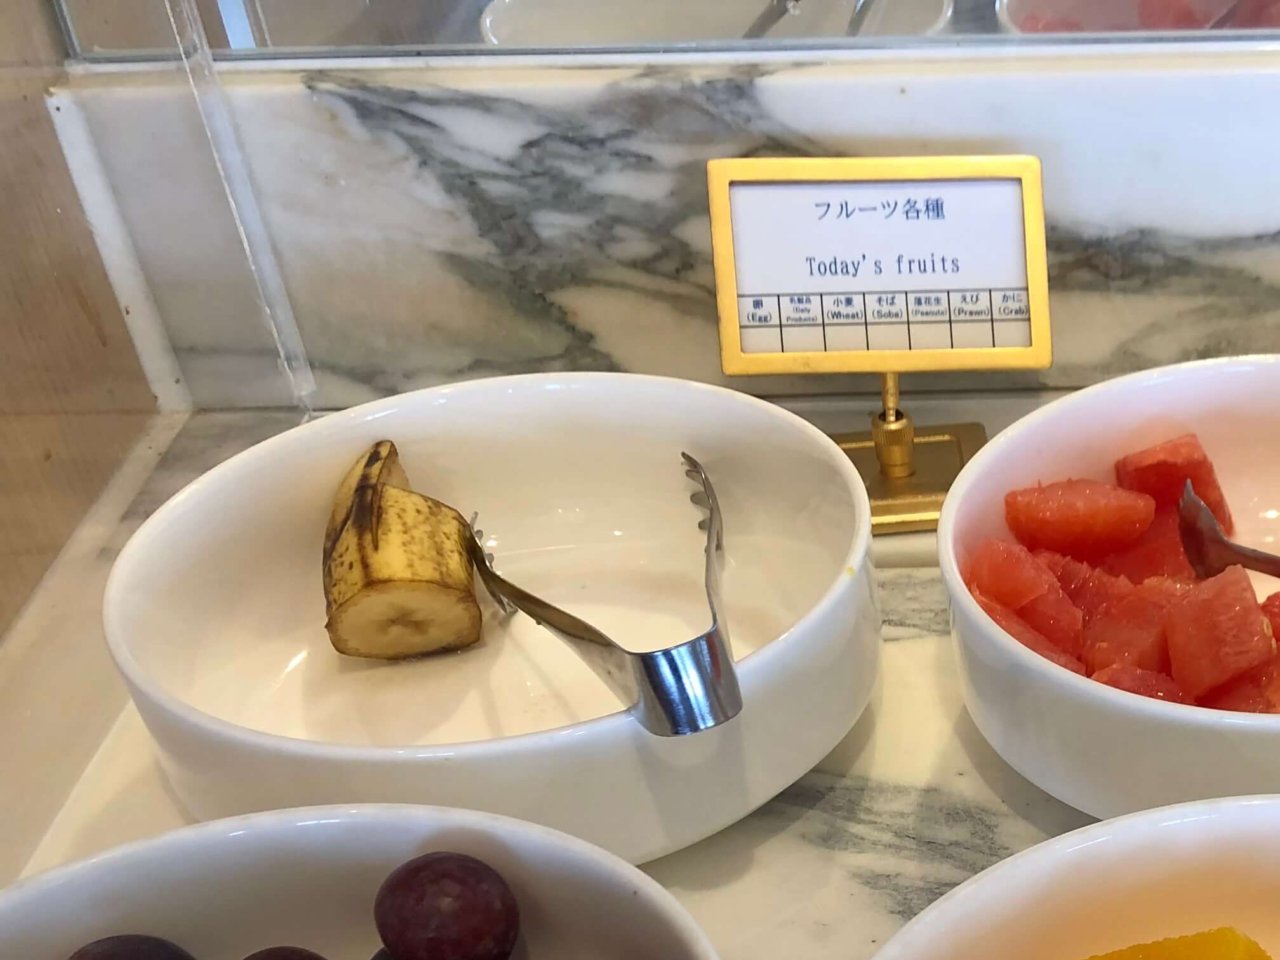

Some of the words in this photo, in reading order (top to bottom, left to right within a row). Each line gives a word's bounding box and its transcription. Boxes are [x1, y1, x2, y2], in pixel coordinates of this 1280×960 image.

[814, 197, 946, 221] フルーツ各種
[805, 254, 883, 278] Today's
[896, 253, 961, 275] fruits
[876, 295, 896, 307] そば
[961, 293, 979, 304] えび
[1002, 292, 1023, 304] かに
[826, 309, 864, 320] (Wheat)
